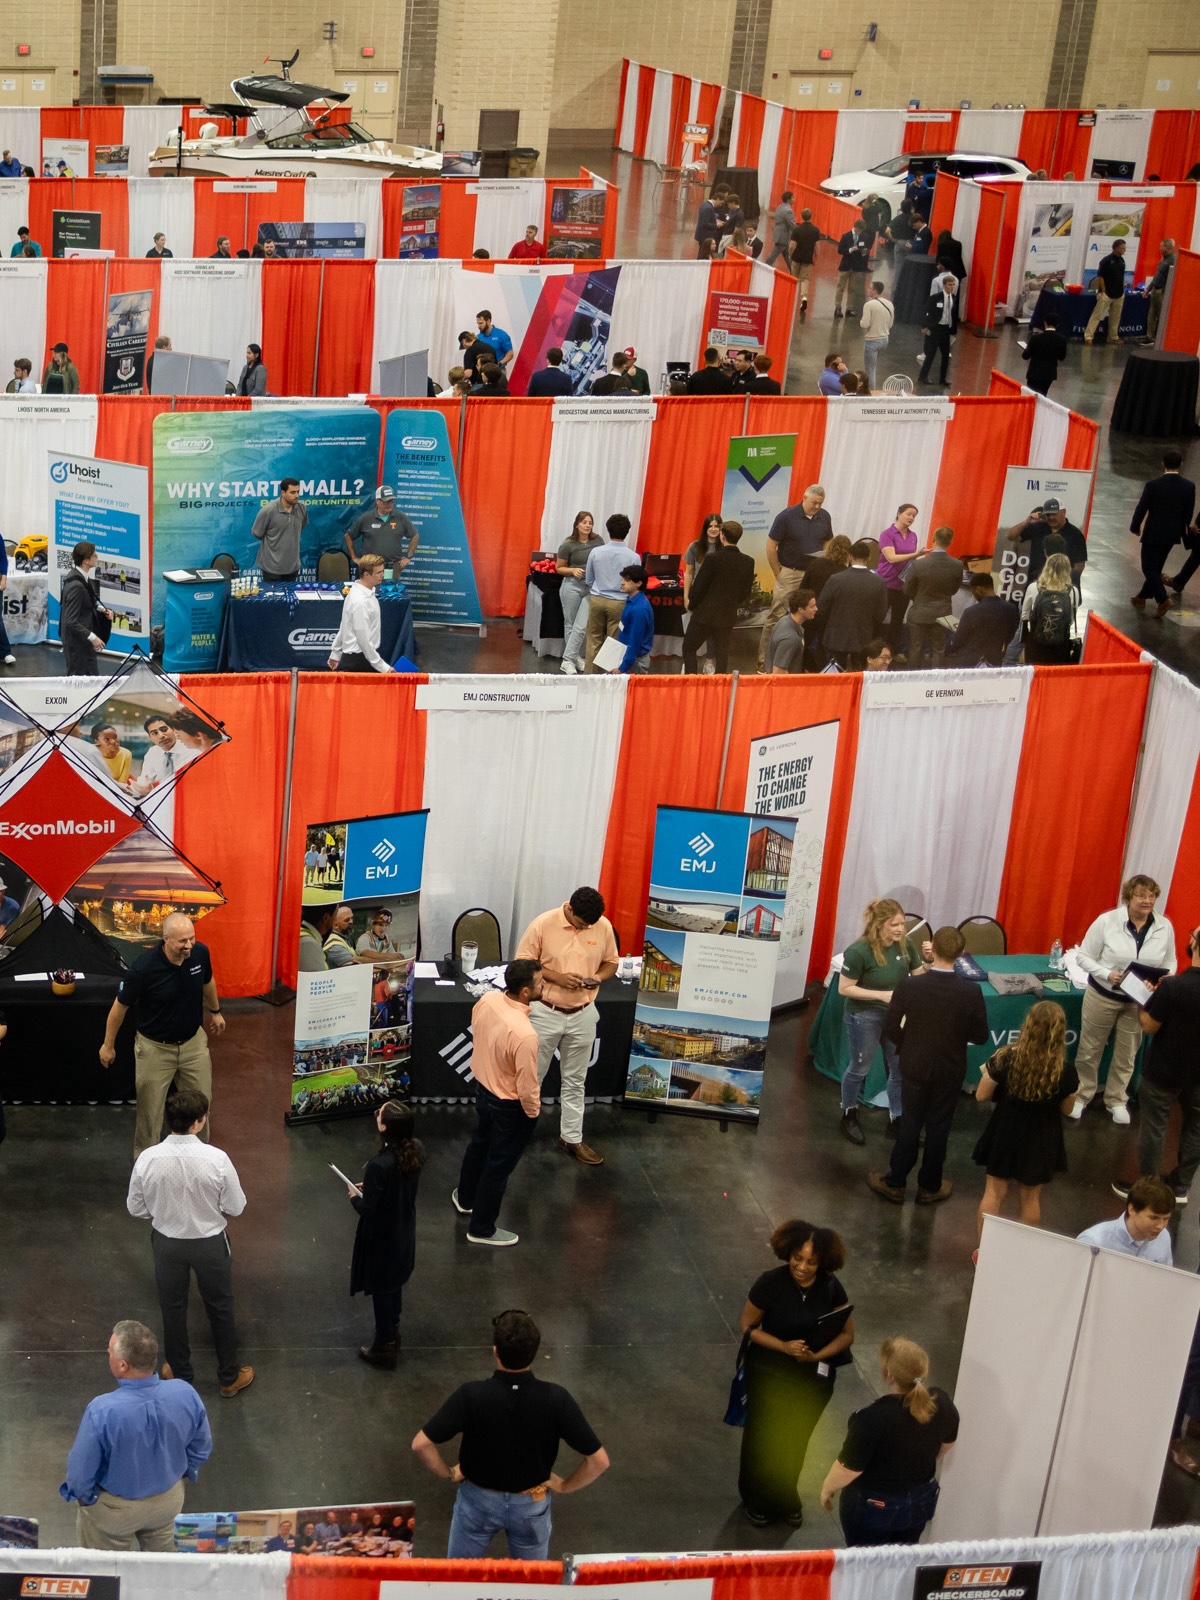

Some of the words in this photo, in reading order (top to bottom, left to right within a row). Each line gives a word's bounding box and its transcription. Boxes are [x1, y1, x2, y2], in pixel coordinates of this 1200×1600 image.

[718, 304, 740, 312] working
[718, 309, 738, 317] greener
[730, 316, 753, 324] mobility
[904, 407, 929, 415] AUTHORITY
[928, 407, 941, 415] (TVA)
[411, 453, 446, 462] BENEFITS
[69, 462, 101, 479] Lhoist
[77, 477, 91, 485] North
[92, 480, 113, 489] America
[167, 482, 217, 499] WHY
[218, 480, 283, 498] START
[299, 479, 365, 496] MALL?
[1026, 480, 1040, 491] TVA
[74, 493, 86, 501] CAN
[96, 497, 114, 506] OFFER
[115, 500, 130, 508] YOU?
[179, 500, 203, 509] BIG
[204, 500, 257, 508] PROJECTS.
[390, 522, 397, 530] T
[1001, 550, 1030, 568] Do
[998, 567, 1028, 585] Go
[463, 693, 478, 702] EMJ
[479, 693, 530, 702] CONSTRUCTION
[925, 689, 934, 698] GE
[935, 688, 964, 698] VERNOVA
[45, 696, 68, 705] EXXON
[759, 764, 777, 783] THE
[778, 755, 814, 778] ENERGY
[757, 783, 769, 799] TO
[770, 773, 808, 796] CHANGE
[755, 798, 773, 815] THE
[774, 790, 806, 811] WORLD
[365, 864, 398, 879] EMJ
[680, 858, 716, 873] EMJ
[310, 983, 336, 991] SERVING
[694, 987, 748, 999] EMJCORP.COM
[308, 1015, 346, 1025] EMJCORP.COM
[962, 1568, 1013, 1582] TEN
[43, 1579, 90, 1594] TEN
[927, 1588, 1025, 1600] CHECKERBOARD
